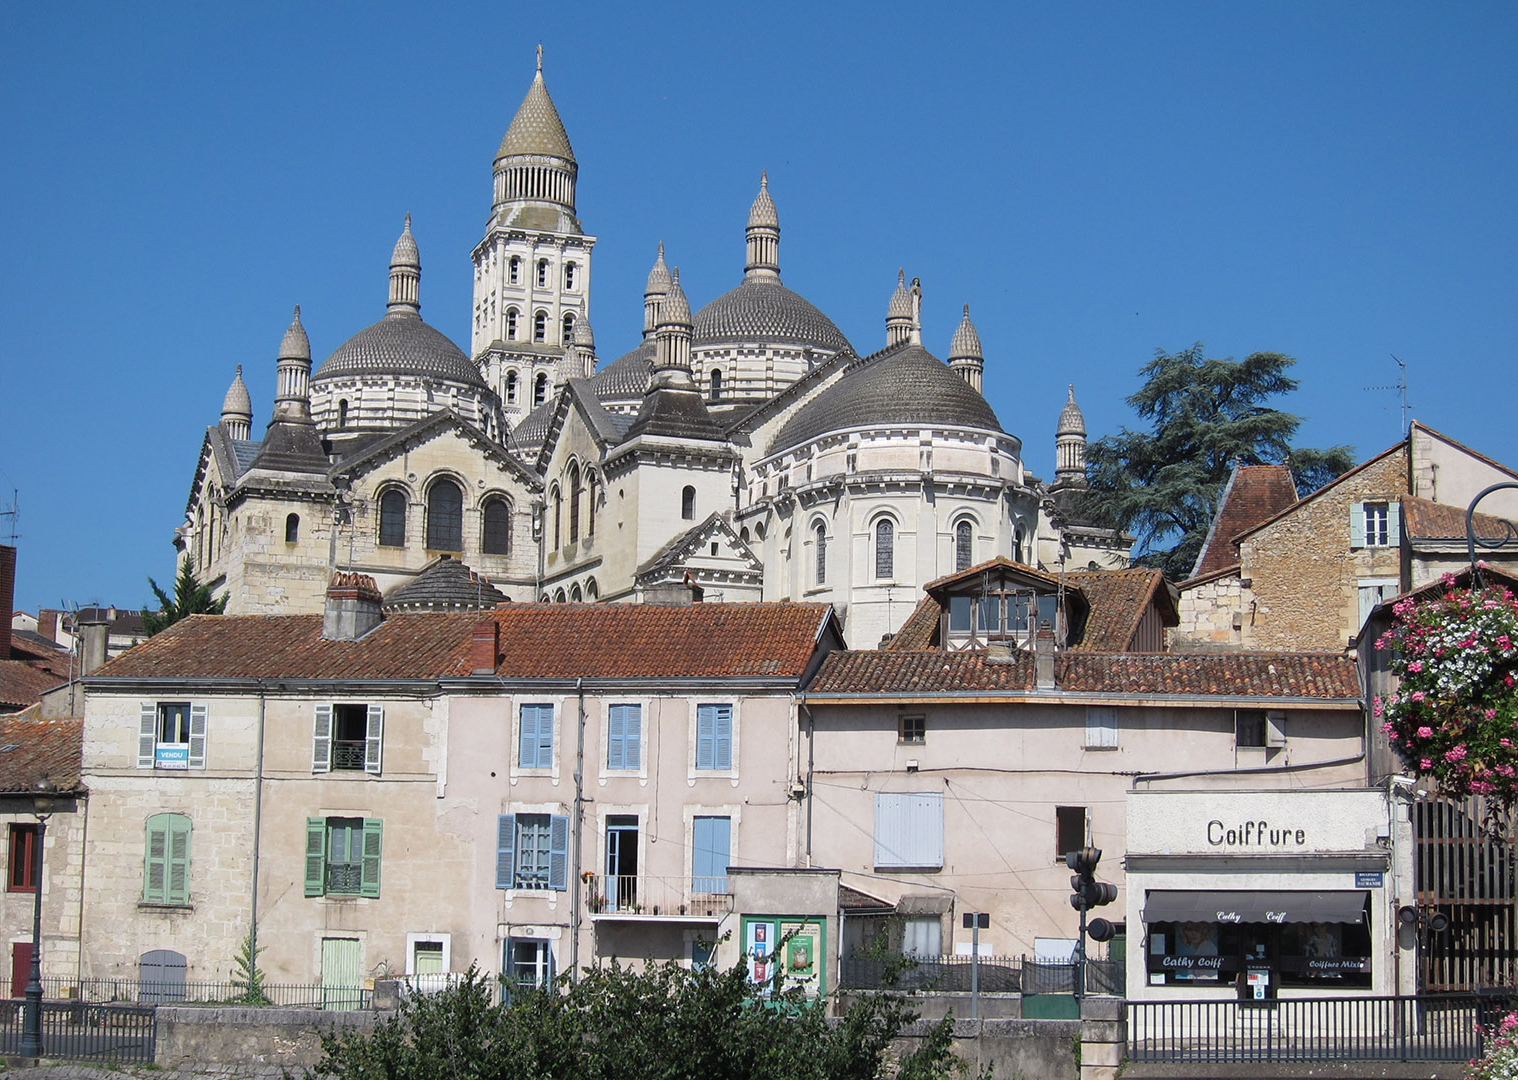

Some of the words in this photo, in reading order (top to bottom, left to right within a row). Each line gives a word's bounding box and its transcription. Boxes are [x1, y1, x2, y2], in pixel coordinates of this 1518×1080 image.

[1207, 820, 1305, 846] Coiffure
[1216, 911, 1241, 923] Cathy
[1162, 957, 1194, 969] Cathy
[1309, 960, 1339, 969] Coiffure
